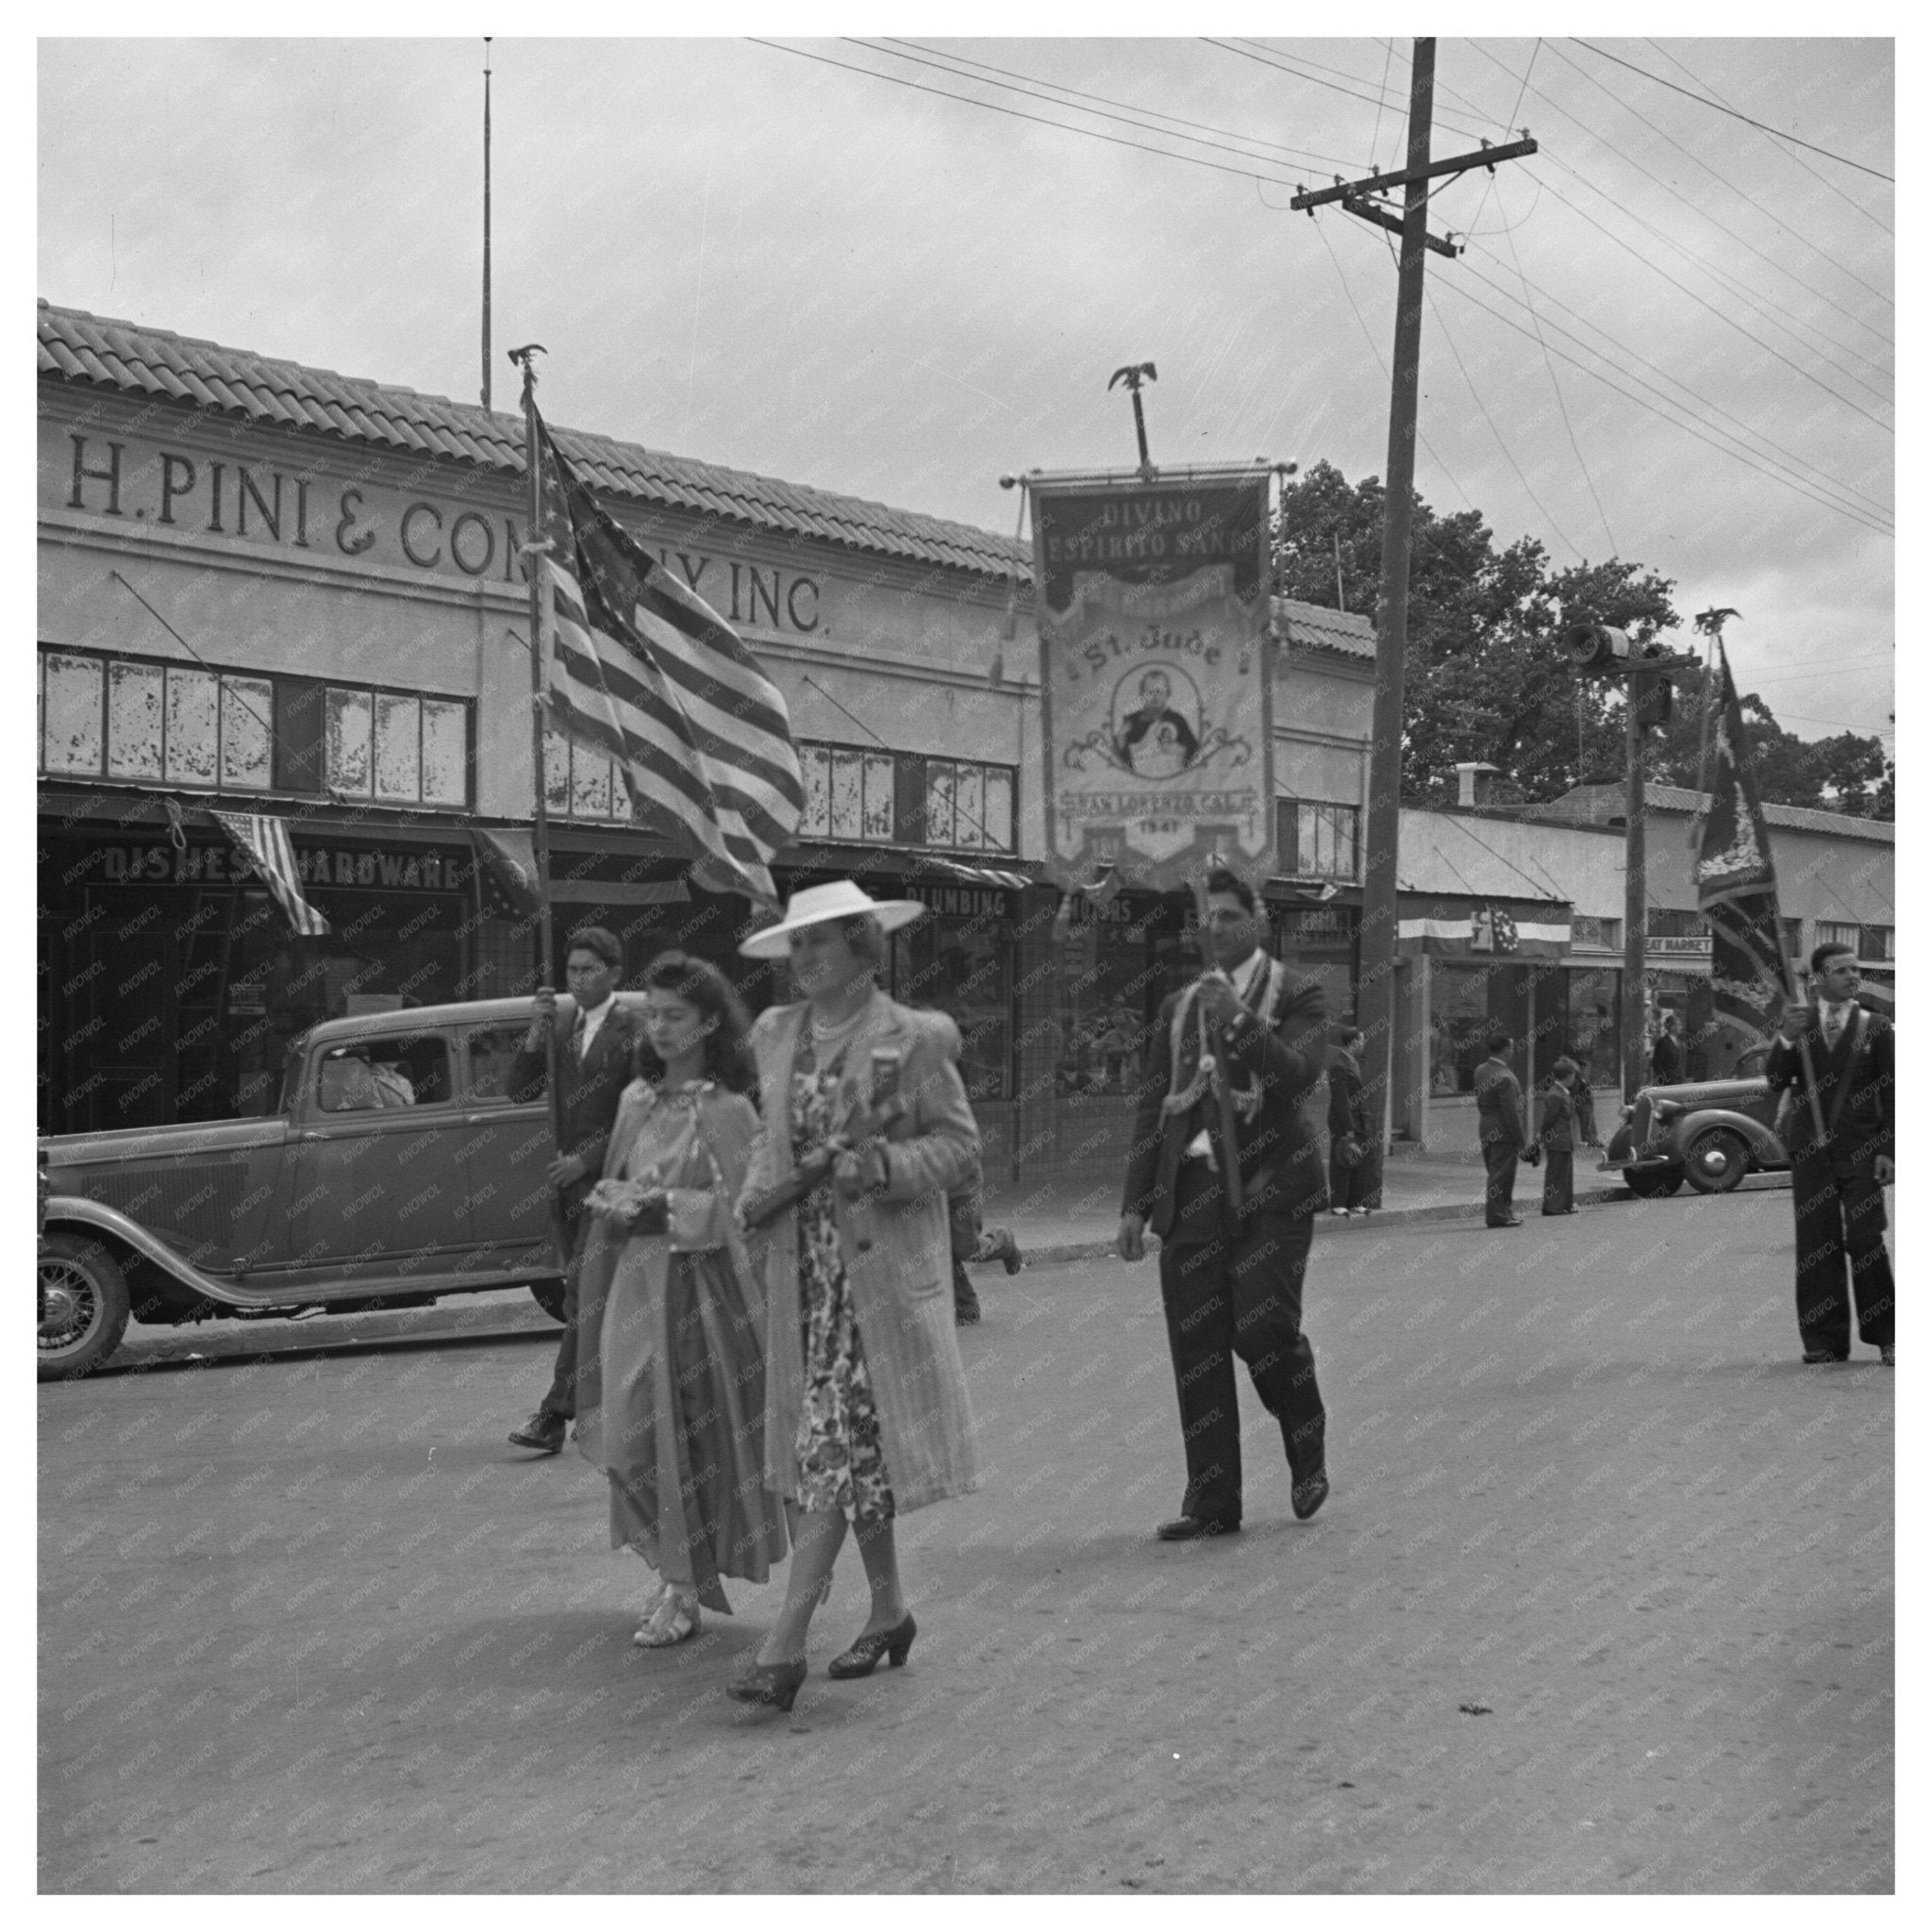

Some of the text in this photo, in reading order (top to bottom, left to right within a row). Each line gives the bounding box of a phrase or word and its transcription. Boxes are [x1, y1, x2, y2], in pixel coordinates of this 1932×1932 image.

[1103, 501, 1201, 526] DIVINO
[1048, 532, 1165, 560] ESPIRITO
[336, 489, 376, 556] &
[729, 562, 831, 635] INC.
[1141, 624, 1221, 666] Jude
[104, 847, 258, 880] DISHES
[1666, 940, 1711, 952] MARKET
